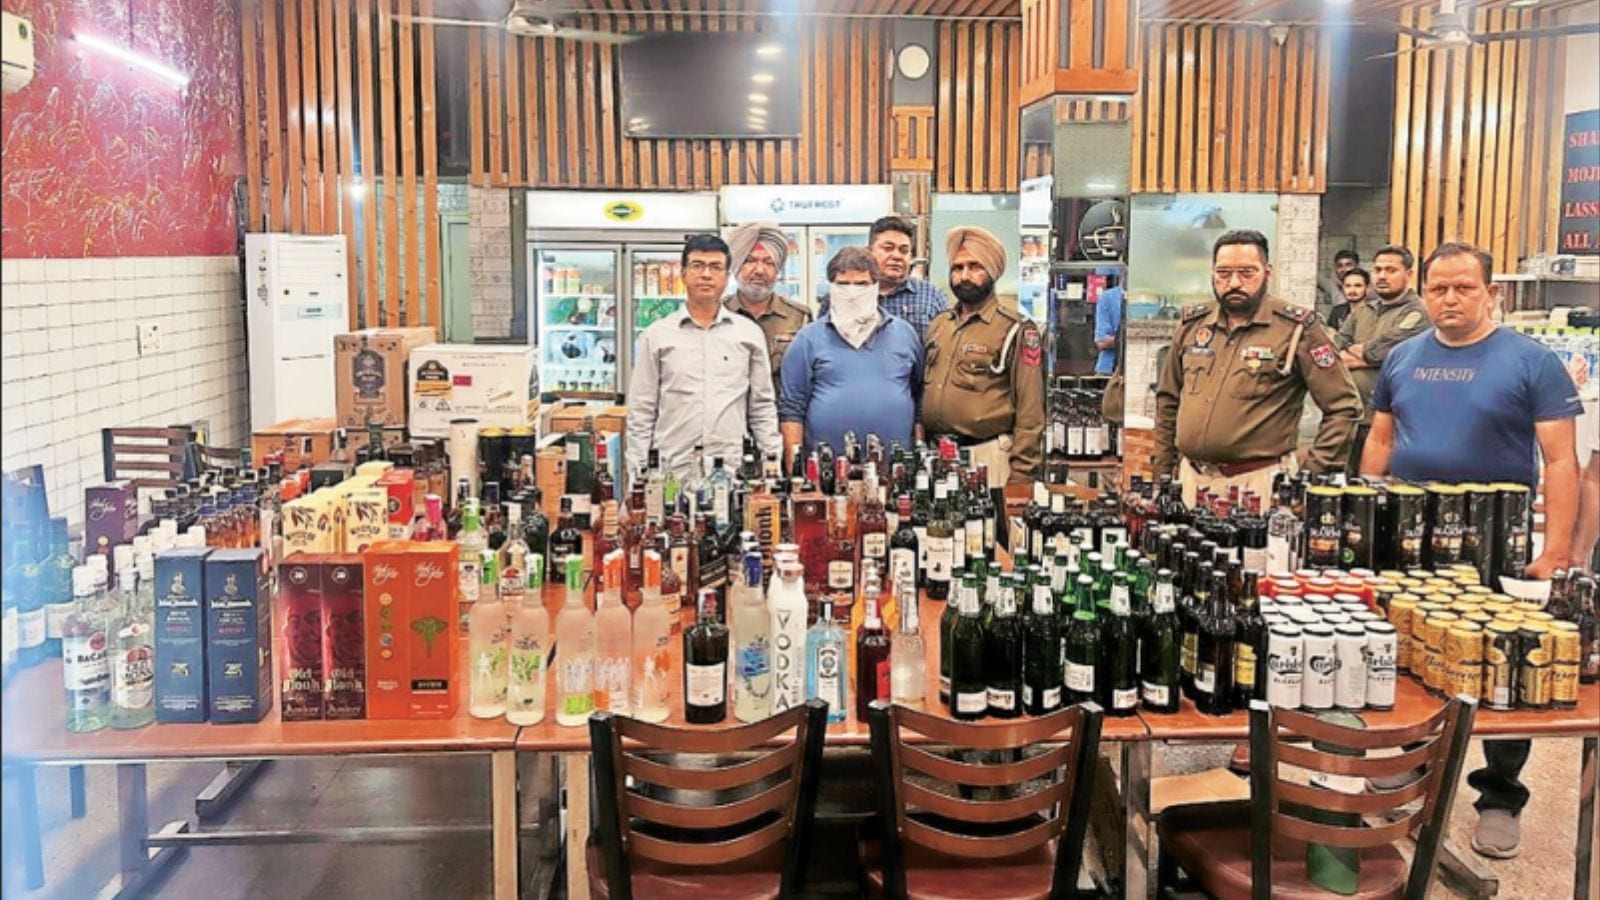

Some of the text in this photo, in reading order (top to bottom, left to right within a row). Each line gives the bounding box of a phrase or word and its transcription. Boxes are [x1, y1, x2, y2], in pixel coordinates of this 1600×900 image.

[1564, 233, 1590, 249] ALL
[1413, 366, 1476, 385] INTENSITY
[775, 608, 791, 712] VODKA
